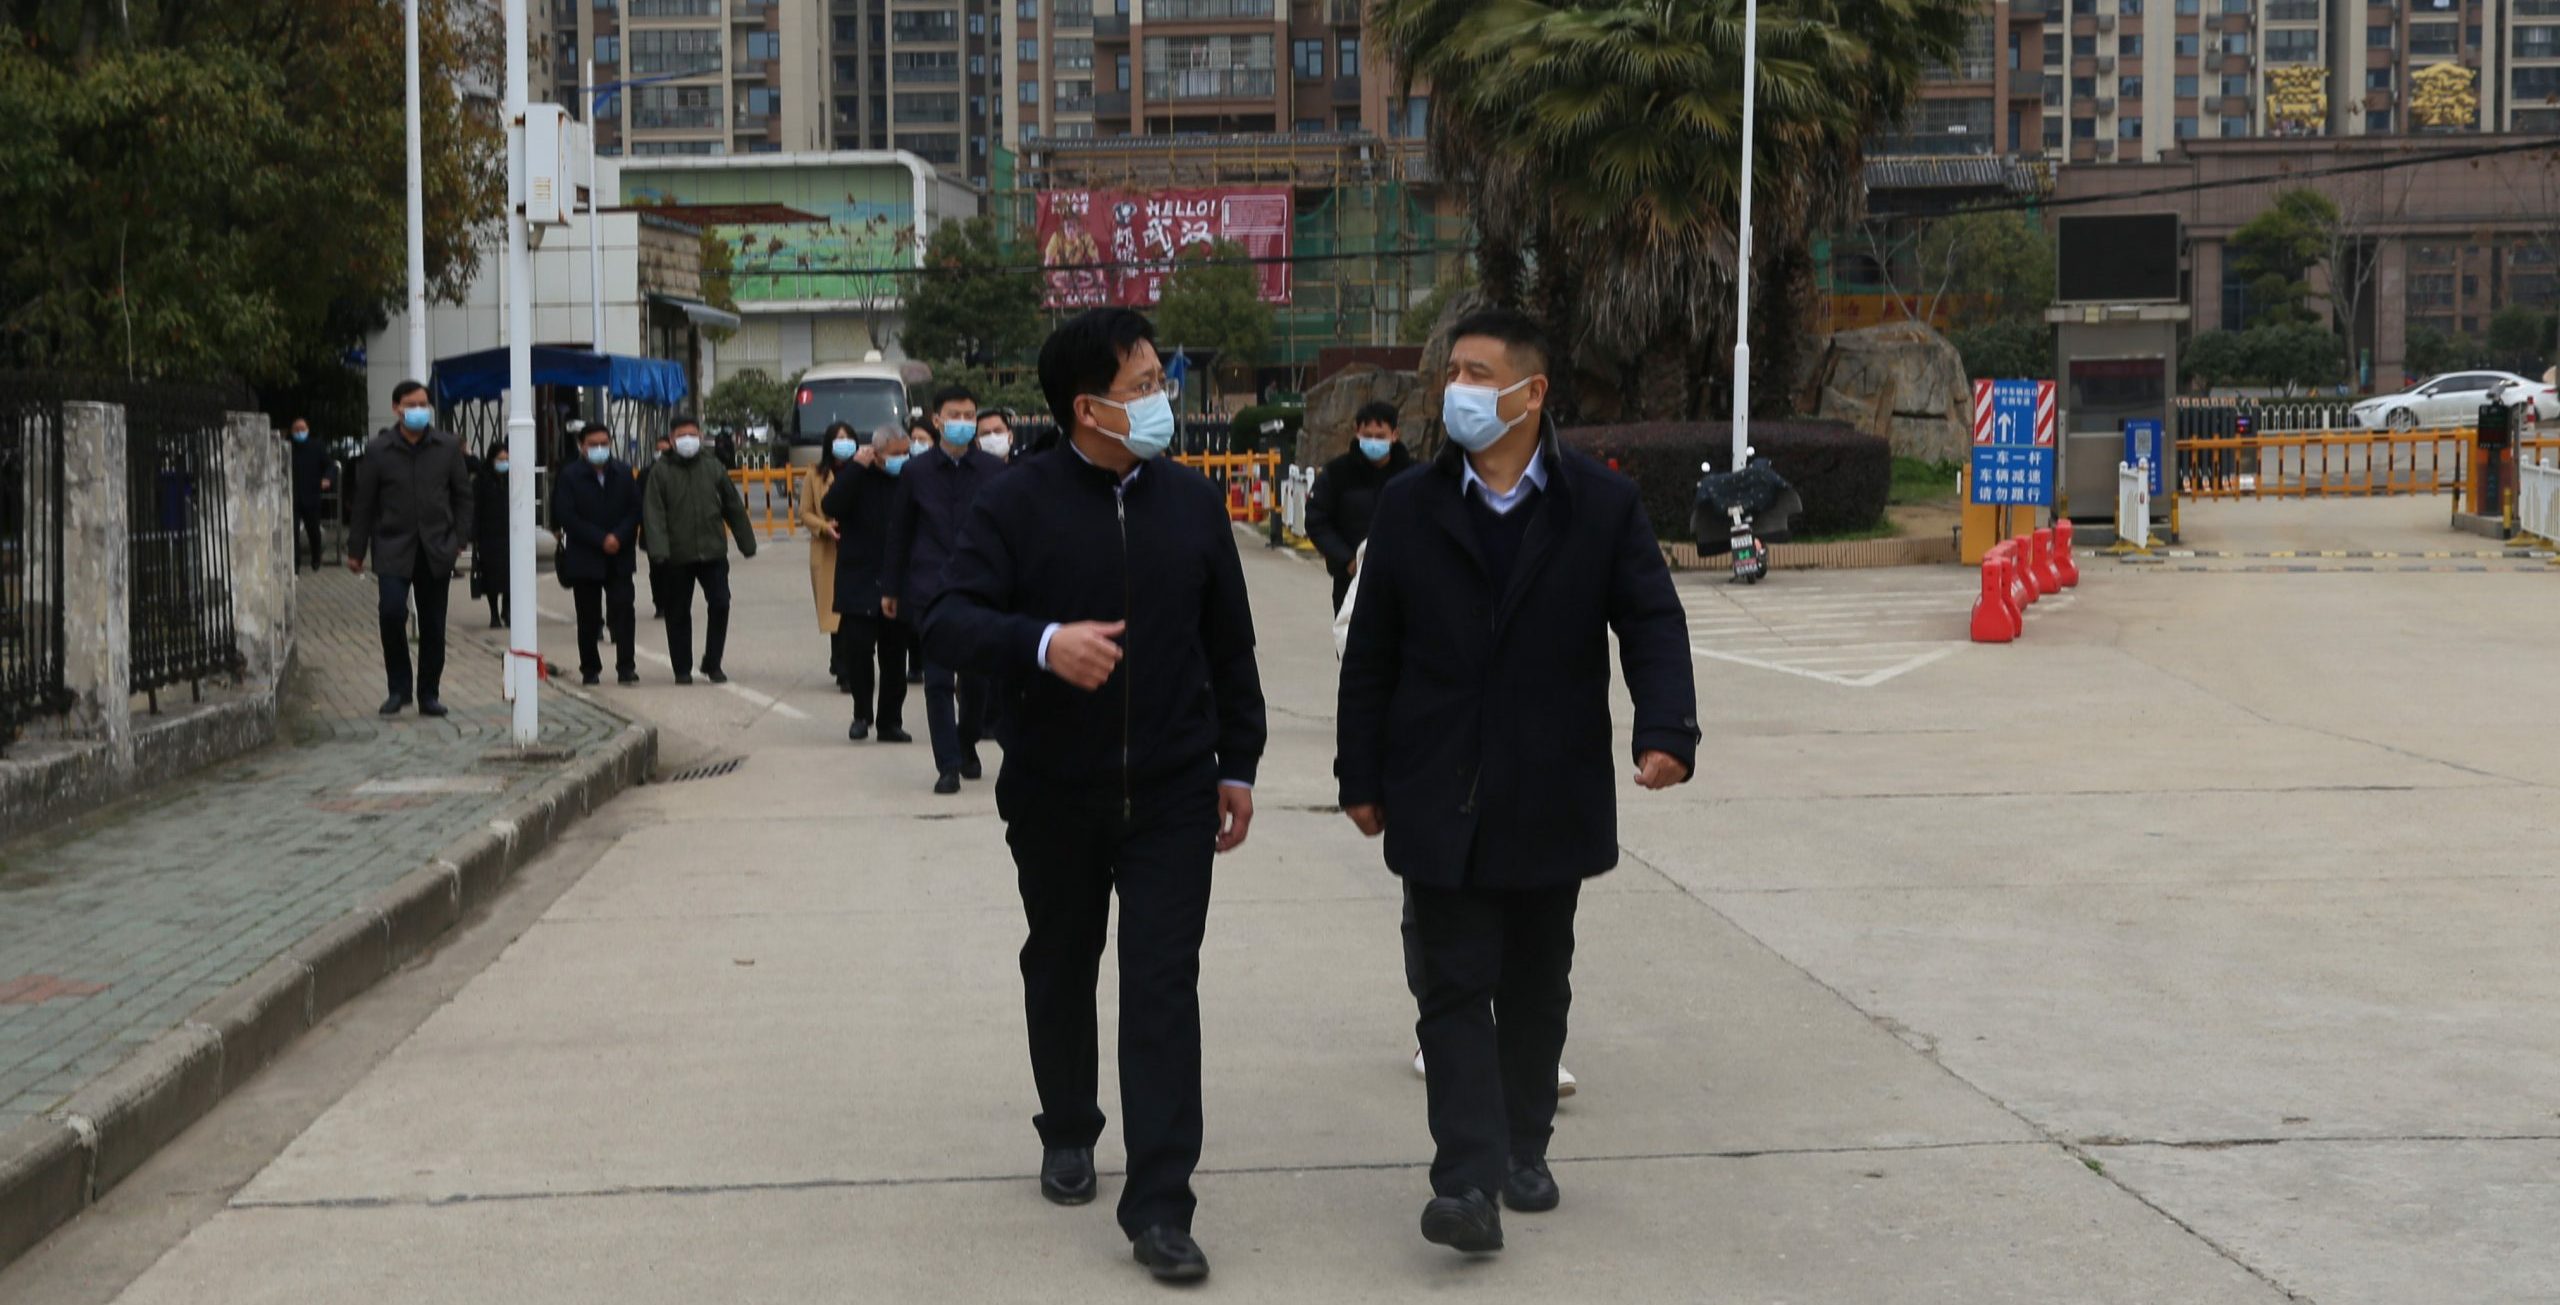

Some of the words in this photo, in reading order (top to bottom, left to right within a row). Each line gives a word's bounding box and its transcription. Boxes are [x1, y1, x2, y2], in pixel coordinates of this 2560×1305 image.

[1142, 217, 1215, 260] 武汉
[1980, 451, 2042, 465] 一车一杆
[1979, 468, 2042, 484] 车辆减速
[1979, 486, 2041, 502] 请勿跟行
